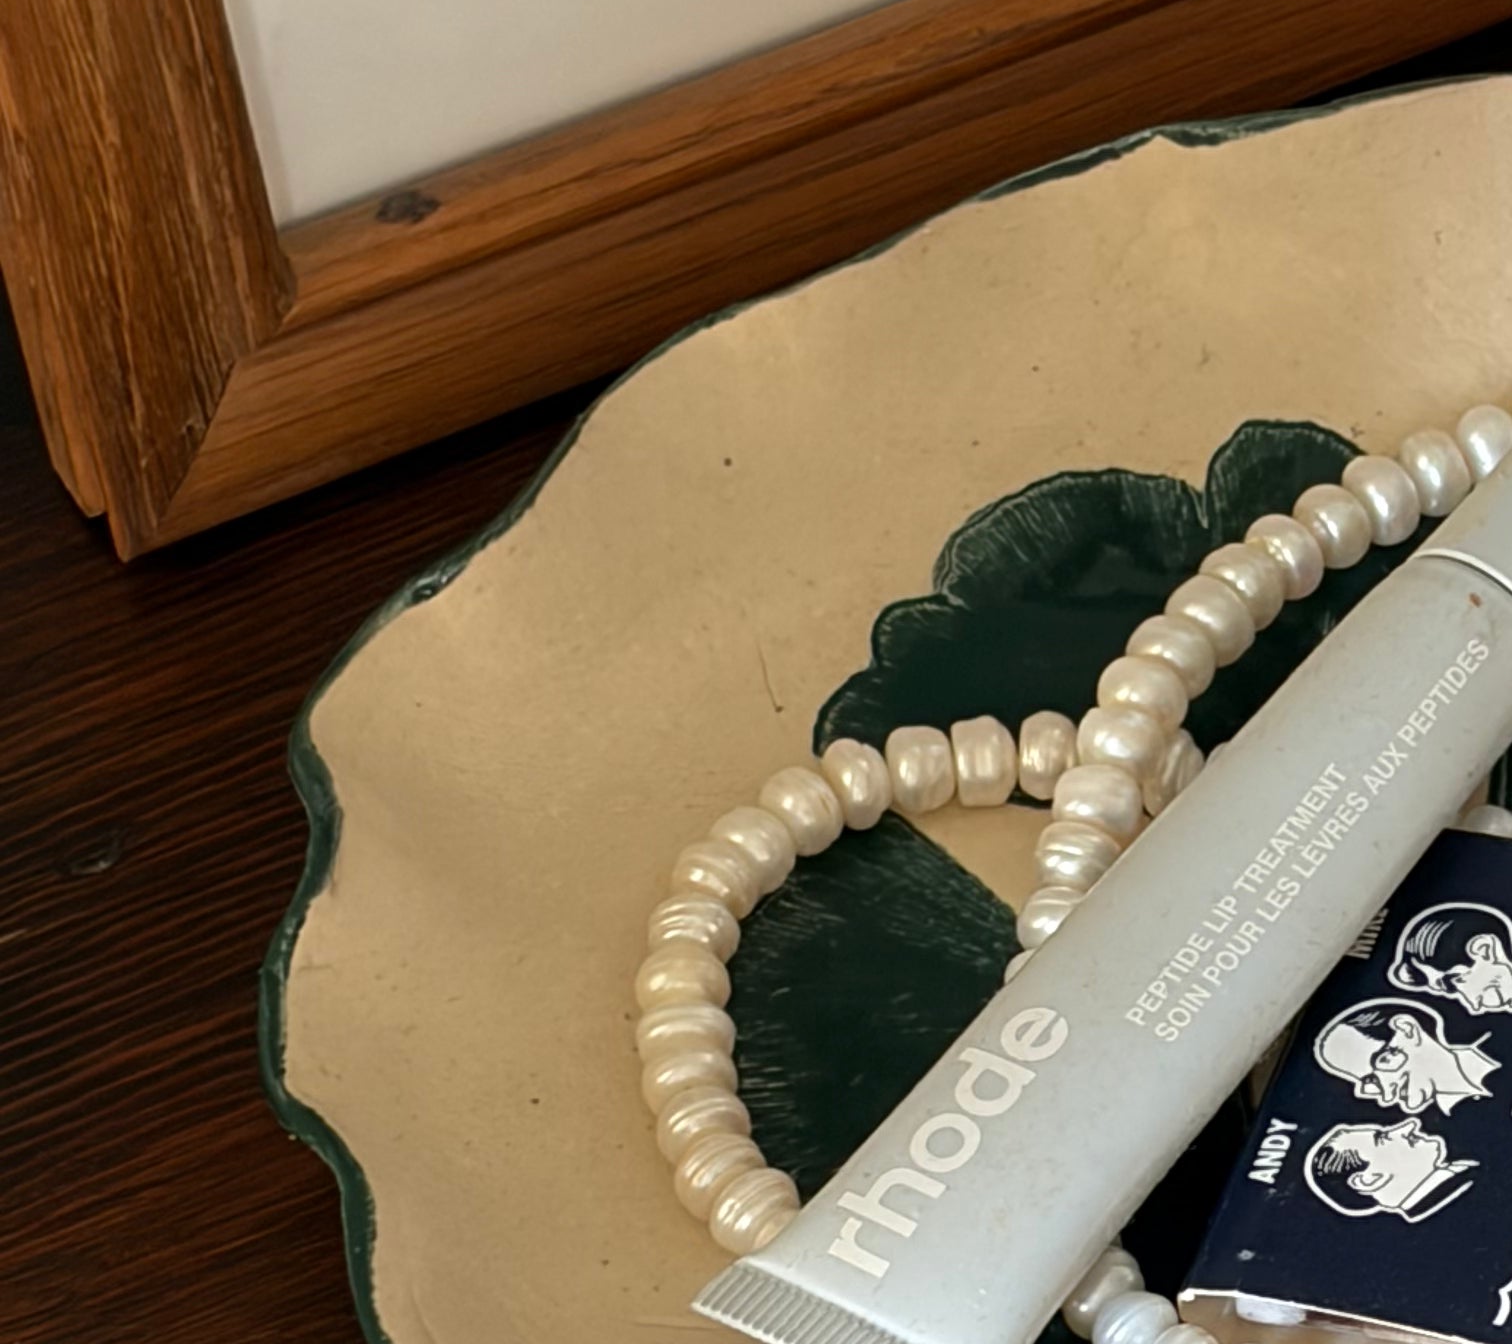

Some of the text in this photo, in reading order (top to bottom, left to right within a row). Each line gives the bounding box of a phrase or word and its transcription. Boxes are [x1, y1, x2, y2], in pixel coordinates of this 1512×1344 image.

[1125, 763, 1346, 1026] PEPTIDE LIP TREATMENT
[1154, 639, 1489, 1042] SOIN POUR LES LÈVRES AUX PEPTIDES
[828, 1007, 1069, 1278] rhode
[1248, 1117, 1298, 1184] ANDY
